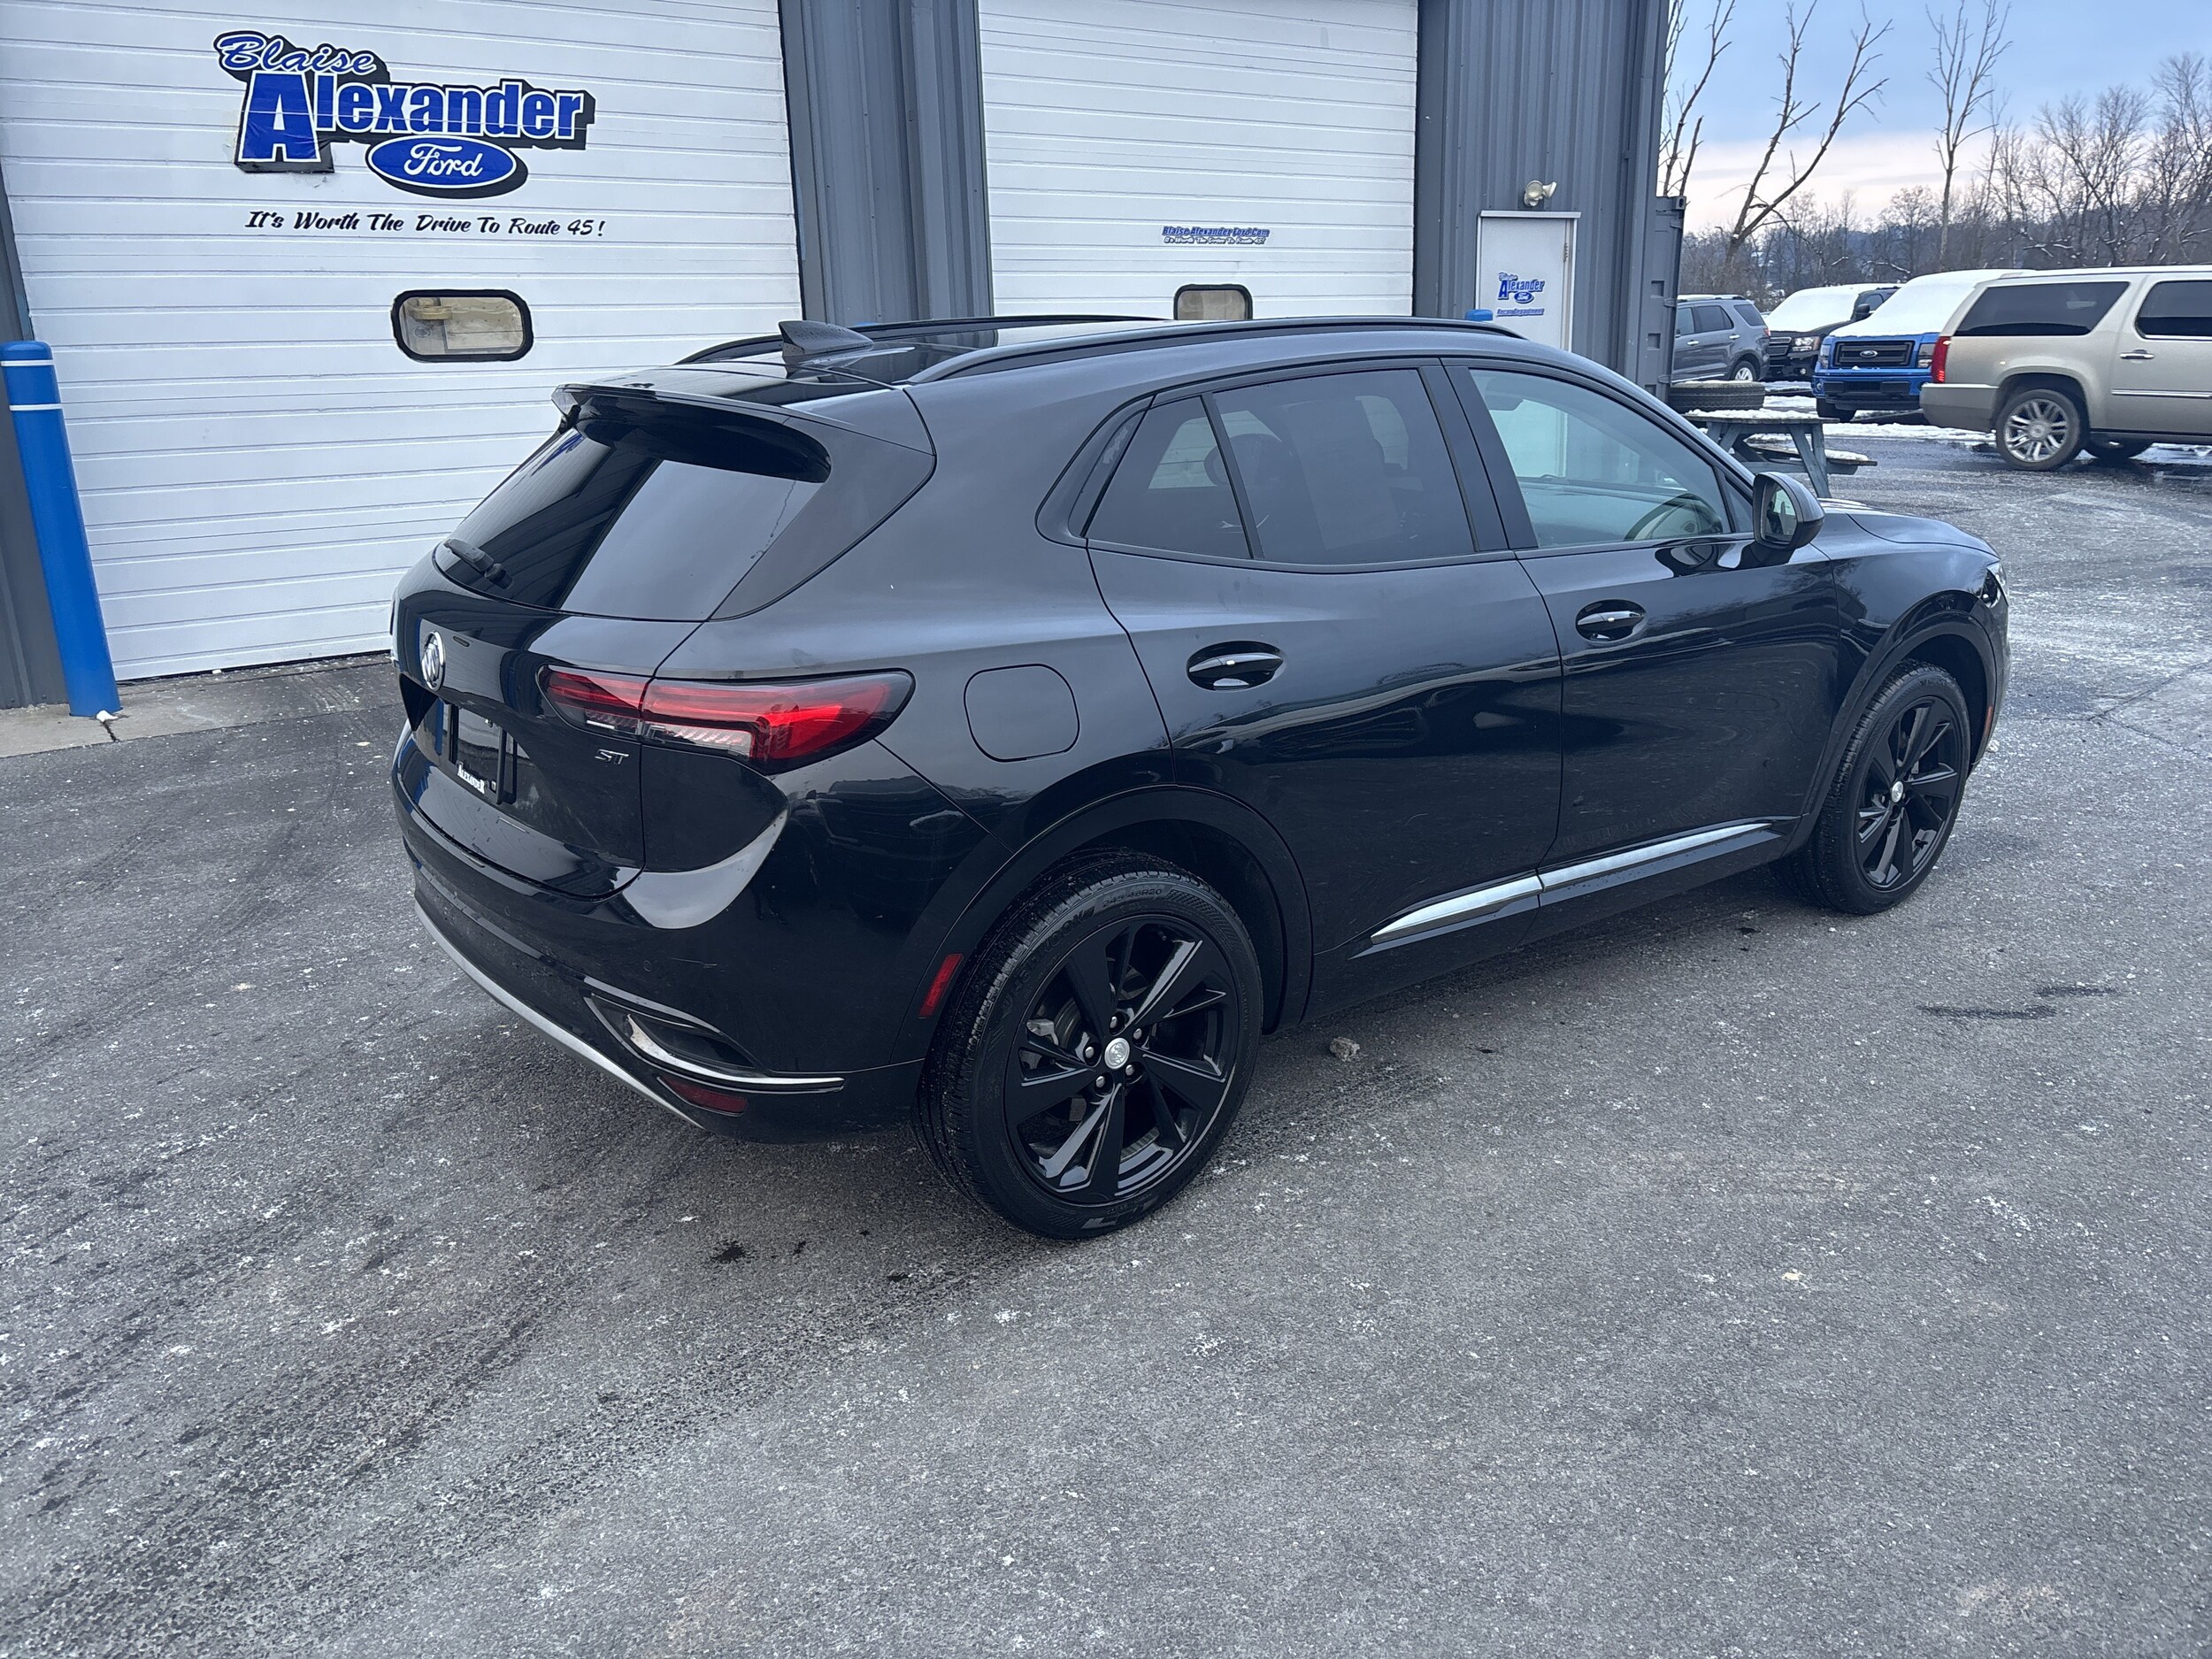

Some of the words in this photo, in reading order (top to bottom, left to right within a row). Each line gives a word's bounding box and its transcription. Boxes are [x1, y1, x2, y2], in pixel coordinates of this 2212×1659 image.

[218, 34, 378, 76] Blaise
[238, 69, 585, 164] Alexander
[403, 143, 484, 177] Ford
[244, 210, 285, 228] It's
[293, 211, 361, 230] Worth
[366, 212, 405, 231] The
[415, 214, 472, 233] Drive
[476, 216, 501, 234] To
[507, 218, 561, 235] Route
[594, 749, 629, 765] ST
